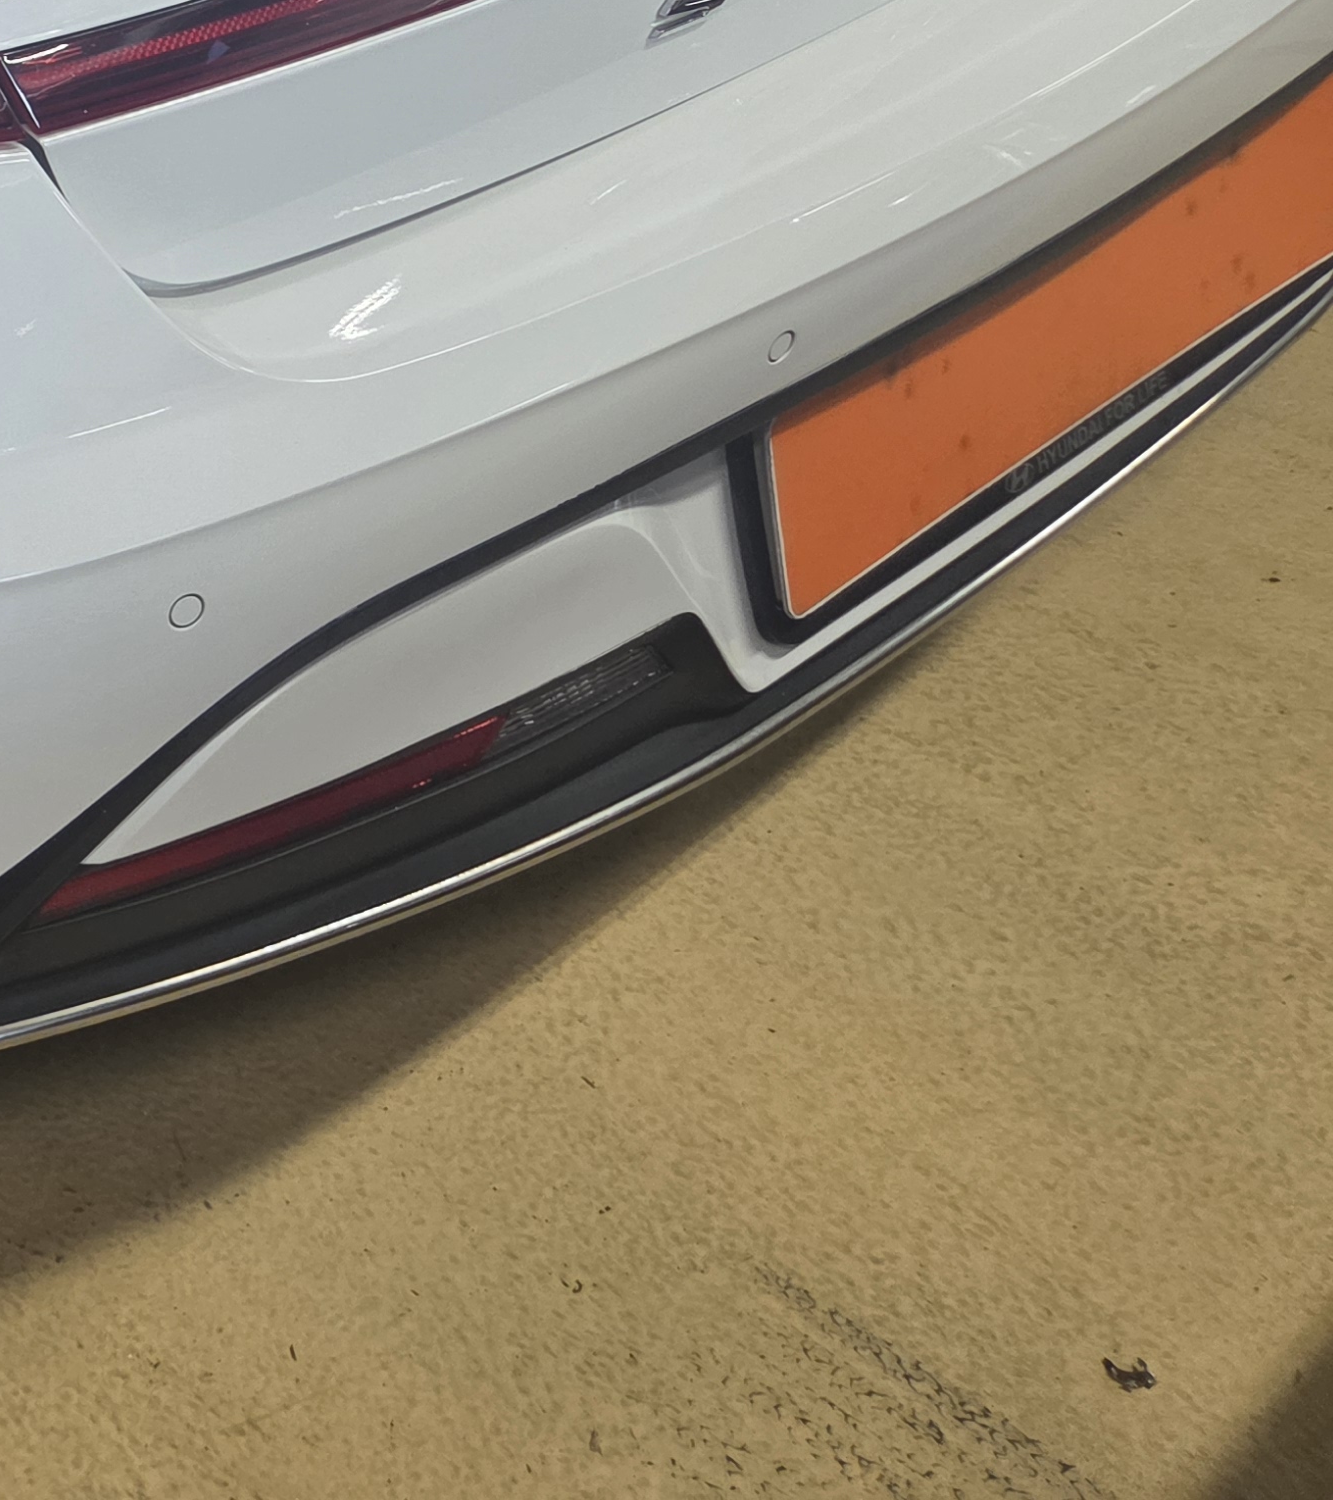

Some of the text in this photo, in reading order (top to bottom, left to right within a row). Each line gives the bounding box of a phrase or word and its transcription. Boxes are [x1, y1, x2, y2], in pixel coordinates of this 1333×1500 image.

[1037, 417, 1105, 473] HYUNDAI
[1105, 393, 1136, 426] FOR
[1137, 371, 1168, 403] LIFE
